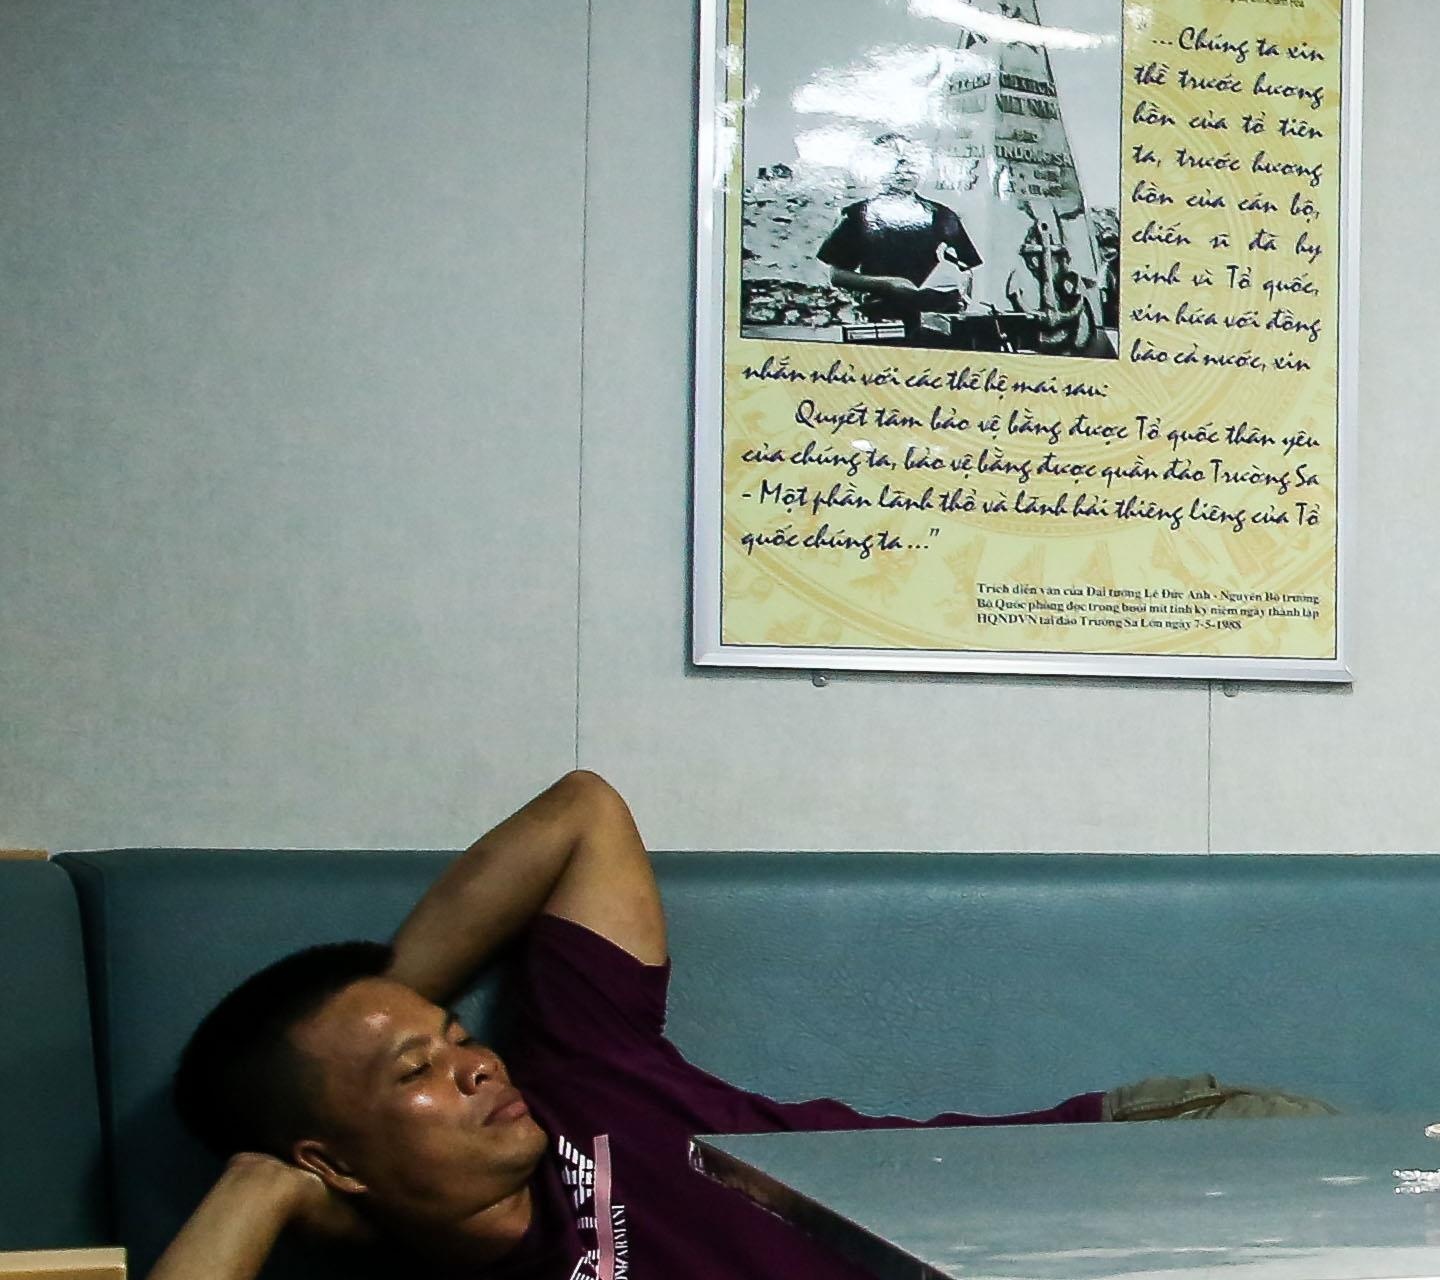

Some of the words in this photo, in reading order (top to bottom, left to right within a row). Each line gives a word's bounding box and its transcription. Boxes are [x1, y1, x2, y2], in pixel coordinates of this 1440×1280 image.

[1256, 38, 1279, 56] ta
[1287, 42, 1325, 62] xin
[1134, 62, 1170, 86] thề
[1178, 69, 1243, 93] trước
[1253, 72, 1324, 110] hương
[1133, 100, 1175, 125] hồn
[1189, 110, 1228, 129] của
[1242, 111, 1266, 134] tổ
[1279, 118, 1324, 139] tiên
[1133, 144, 1161, 167] ta,
[1176, 147, 1241, 170] trước
[1252, 150, 1322, 187] hương
[1132, 179, 1174, 204] hồn
[1186, 188, 1226, 208] của
[1238, 192, 1278, 213] cán
[1290, 192, 1320, 223] bộ,
[1131, 220, 1192, 245] chiến
[1209, 233, 1230, 249] sĩ
[1248, 228, 1279, 251] đã
[1295, 231, 1323, 264] hy
[1132, 262, 1181, 285] sinh
[1192, 269, 1214, 286] vì
[1226, 264, 1252, 290] Tổ
[1263, 273, 1320, 302] quốc,
[1130, 303, 1171, 322] xin
[1175, 301, 1218, 326] hứa
[1224, 310, 1261, 329] với
[1265, 308, 1321, 343] đồng
[1130, 338, 1168, 363] bào
[1173, 342, 1199, 364] cả
[1203, 350, 1266, 372] nước,
[1274, 351, 1312, 371] xin
[742, 356, 806, 382] nhắn
[811, 359, 855, 384] nhủ
[862, 368, 901, 386] với
[905, 368, 943, 389] các
[947, 367, 984, 391] thế
[984, 367, 1008, 399] hệ
[1012, 376, 1057, 395] mai
[1063, 379, 1109, 398] sau:
[795, 399, 868, 435] Quyết
[875, 407, 923, 428] tâm
[930, 405, 968, 431] bảo
[977, 414, 1001, 440] vệ
[1008, 408, 1062, 445] bằng
[1069, 414, 1128, 446] được
[1135, 415, 1161, 441] Tổ
[1167, 422, 1220, 452] quốc
[1225, 421, 1276, 447] thân
[1281, 431, 1321, 457] yêu
[741, 443, 785, 463] của
[790, 440, 862, 477] chúng
[866, 448, 897, 470] ta,
[904, 445, 946, 470] bảo
[951, 455, 974, 480] vệ
[977, 446, 1032, 484] bằng
[1036, 451, 1098, 484] được
[1101, 455, 1158, 488] quần
[1163, 458, 1205, 482] đảo
[1209, 458, 1289, 495] Trường
[1294, 463, 1320, 488] Sa
[760, 478, 808, 513] Một
[812, 482, 873, 515] phần
[878, 483, 933, 512] lãnh
[938, 487, 977, 512] thổ
[983, 492, 1009, 514] và
[1014, 488, 1068, 516] lãnh
[1072, 494, 1109, 518] hải
[1115, 495, 1183, 530] thiêng
[1190, 498, 1246, 532] liêng
[1251, 505, 1290, 525] của
[1295, 502, 1321, 526] Tổ
[741, 525, 800, 556] quốc
[802, 523, 870, 560] chúng
